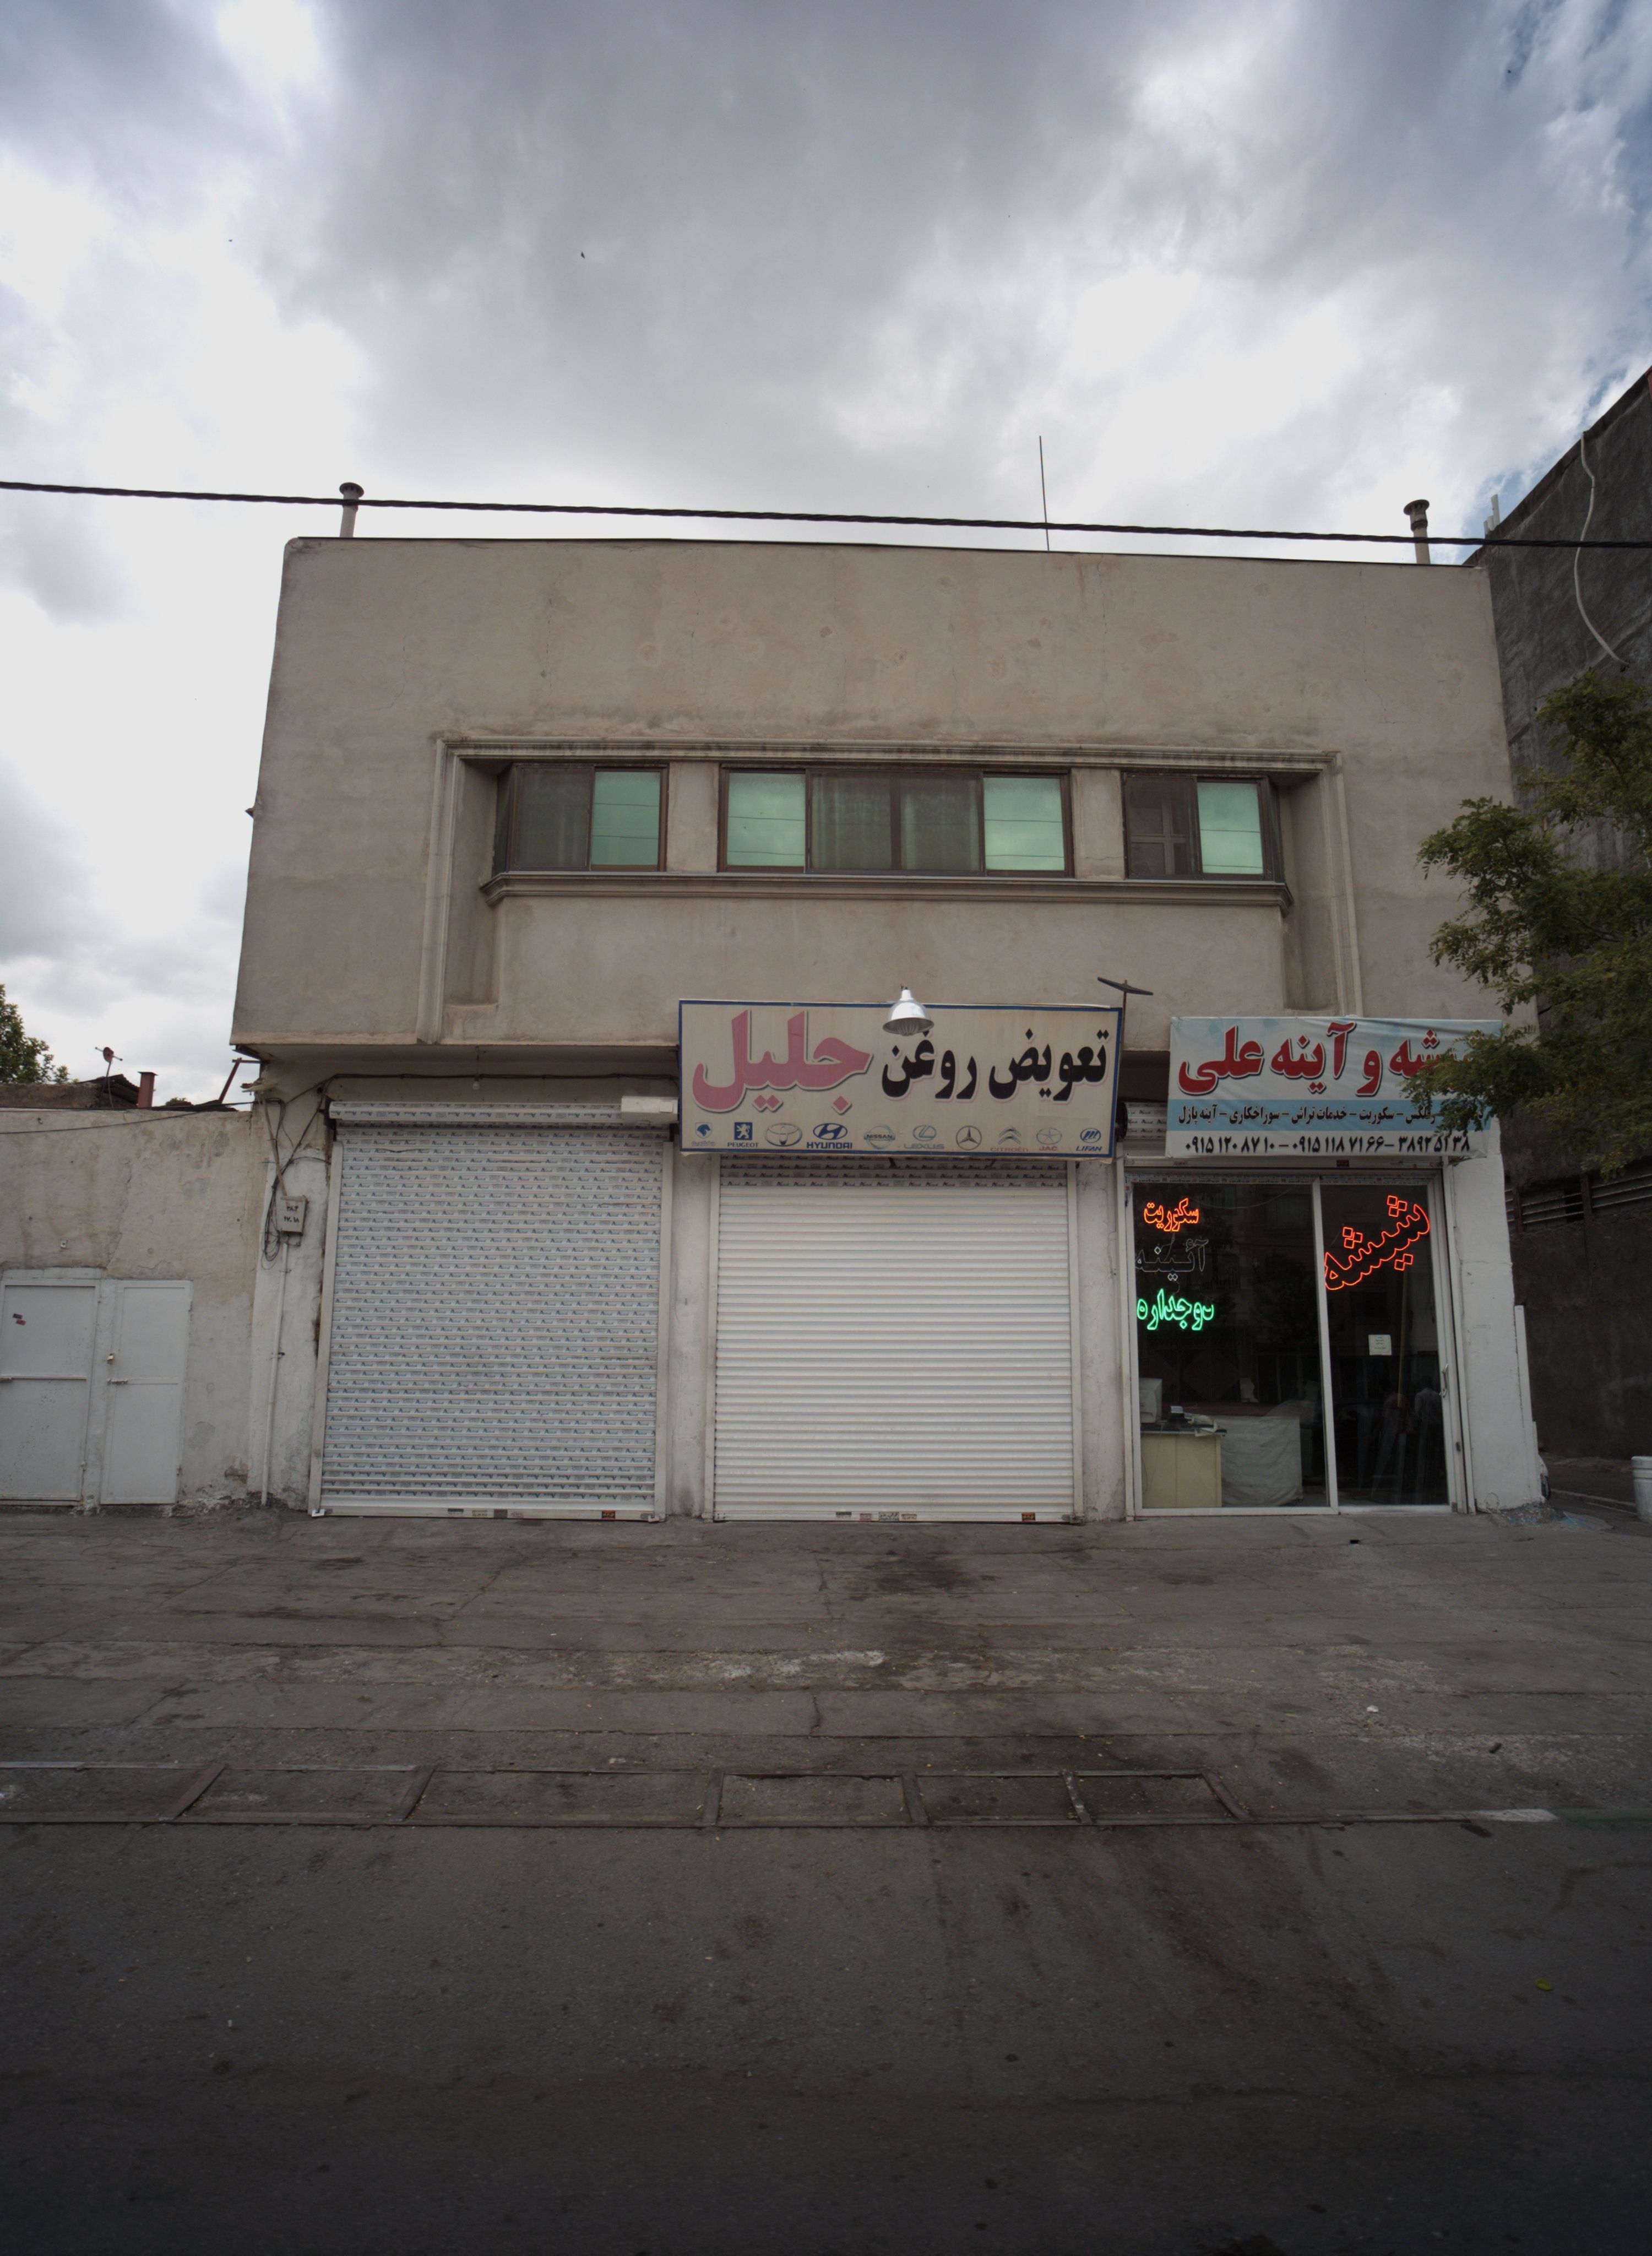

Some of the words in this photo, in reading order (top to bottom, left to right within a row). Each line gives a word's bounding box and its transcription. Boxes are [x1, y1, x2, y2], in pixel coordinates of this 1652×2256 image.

[692, 1010, 874, 1114] جلیل
[882, 1029, 978, 1100] روغن
[990, 1028, 1110, 1101] تعویض
[1178, 1024, 1264, 1096] علی
[1270, 1021, 1356, 1094] آینه
[1356, 1049, 1382, 1096] و
[1316, 1105, 1347, 1120] خدمات
[1358, 1106, 1394, 1125] سکوریت
[1143, 1197, 1199, 1232] سکوریت
[1324, 1195, 1430, 1290] شیشه
